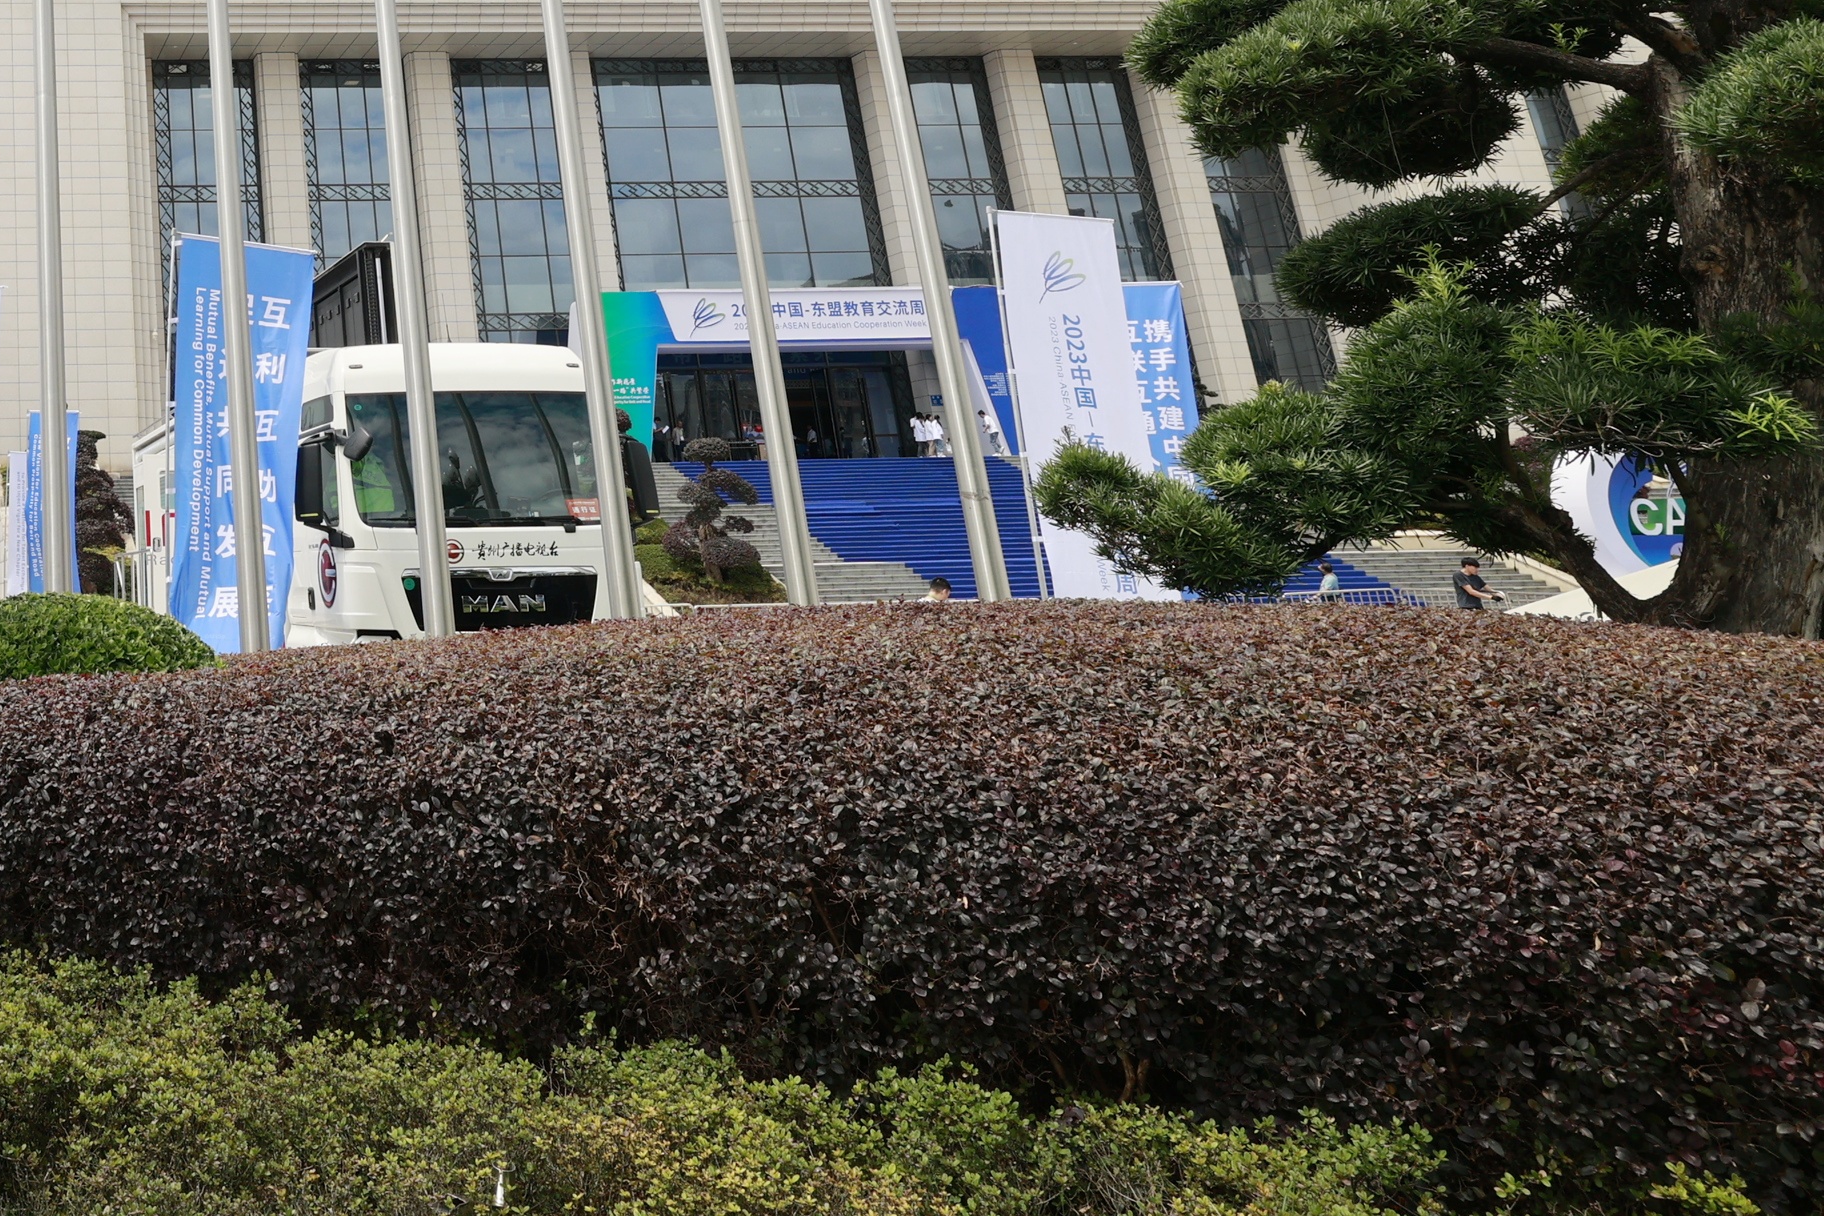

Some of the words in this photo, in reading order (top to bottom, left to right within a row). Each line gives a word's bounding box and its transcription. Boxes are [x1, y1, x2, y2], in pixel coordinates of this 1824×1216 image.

[192, 286, 207, 351] Learning
[206, 289, 221, 339] Mutual
[731, 300, 925, 319] 20中国-东盟教育交流周
[811, 321, 852, 330] Education
[854, 320, 903, 331] Cooperation
[904, 319, 927, 329] Week
[1048, 316, 1059, 344] 2023
[194, 354, 205, 376] for
[205, 343, 217, 406] Benefits,
[193, 379, 205, 445] Common
[205, 411, 214, 463] Mutual
[188, 450, 204, 552] Development
[202, 468, 213, 529] Support
[201, 534, 212, 562] and
[194, 566, 211, 619] Mutual
[461, 594, 546, 614] MAN
